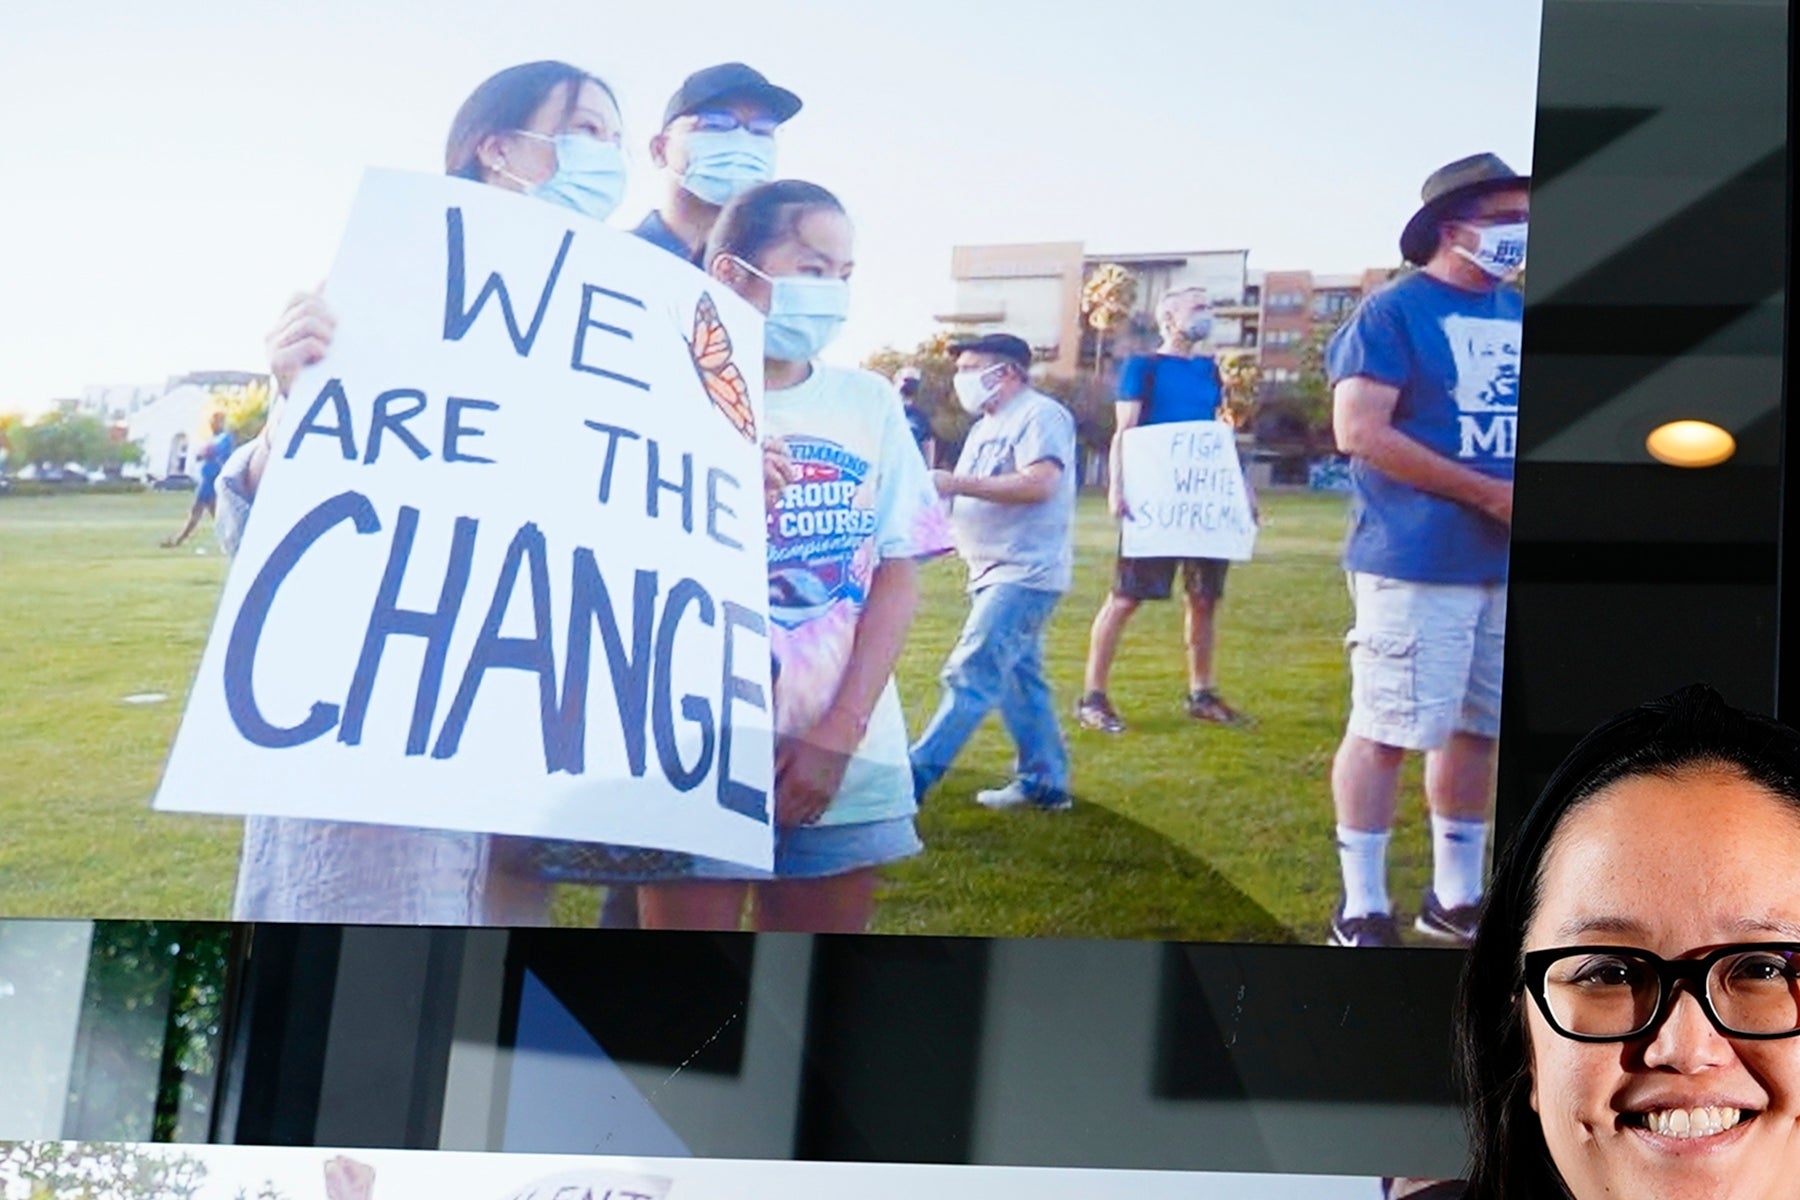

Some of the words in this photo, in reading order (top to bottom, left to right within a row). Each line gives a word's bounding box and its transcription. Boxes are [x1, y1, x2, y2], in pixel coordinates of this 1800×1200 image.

[443, 206, 652, 391] WE
[284, 378, 500, 464] ARE
[583, 420, 745, 551] THE
[774, 481, 856, 509] ROUP
[1173, 466, 1236, 497] WHITE
[779, 509, 876, 538] COURSE
[222, 490, 770, 825] CHANGE
